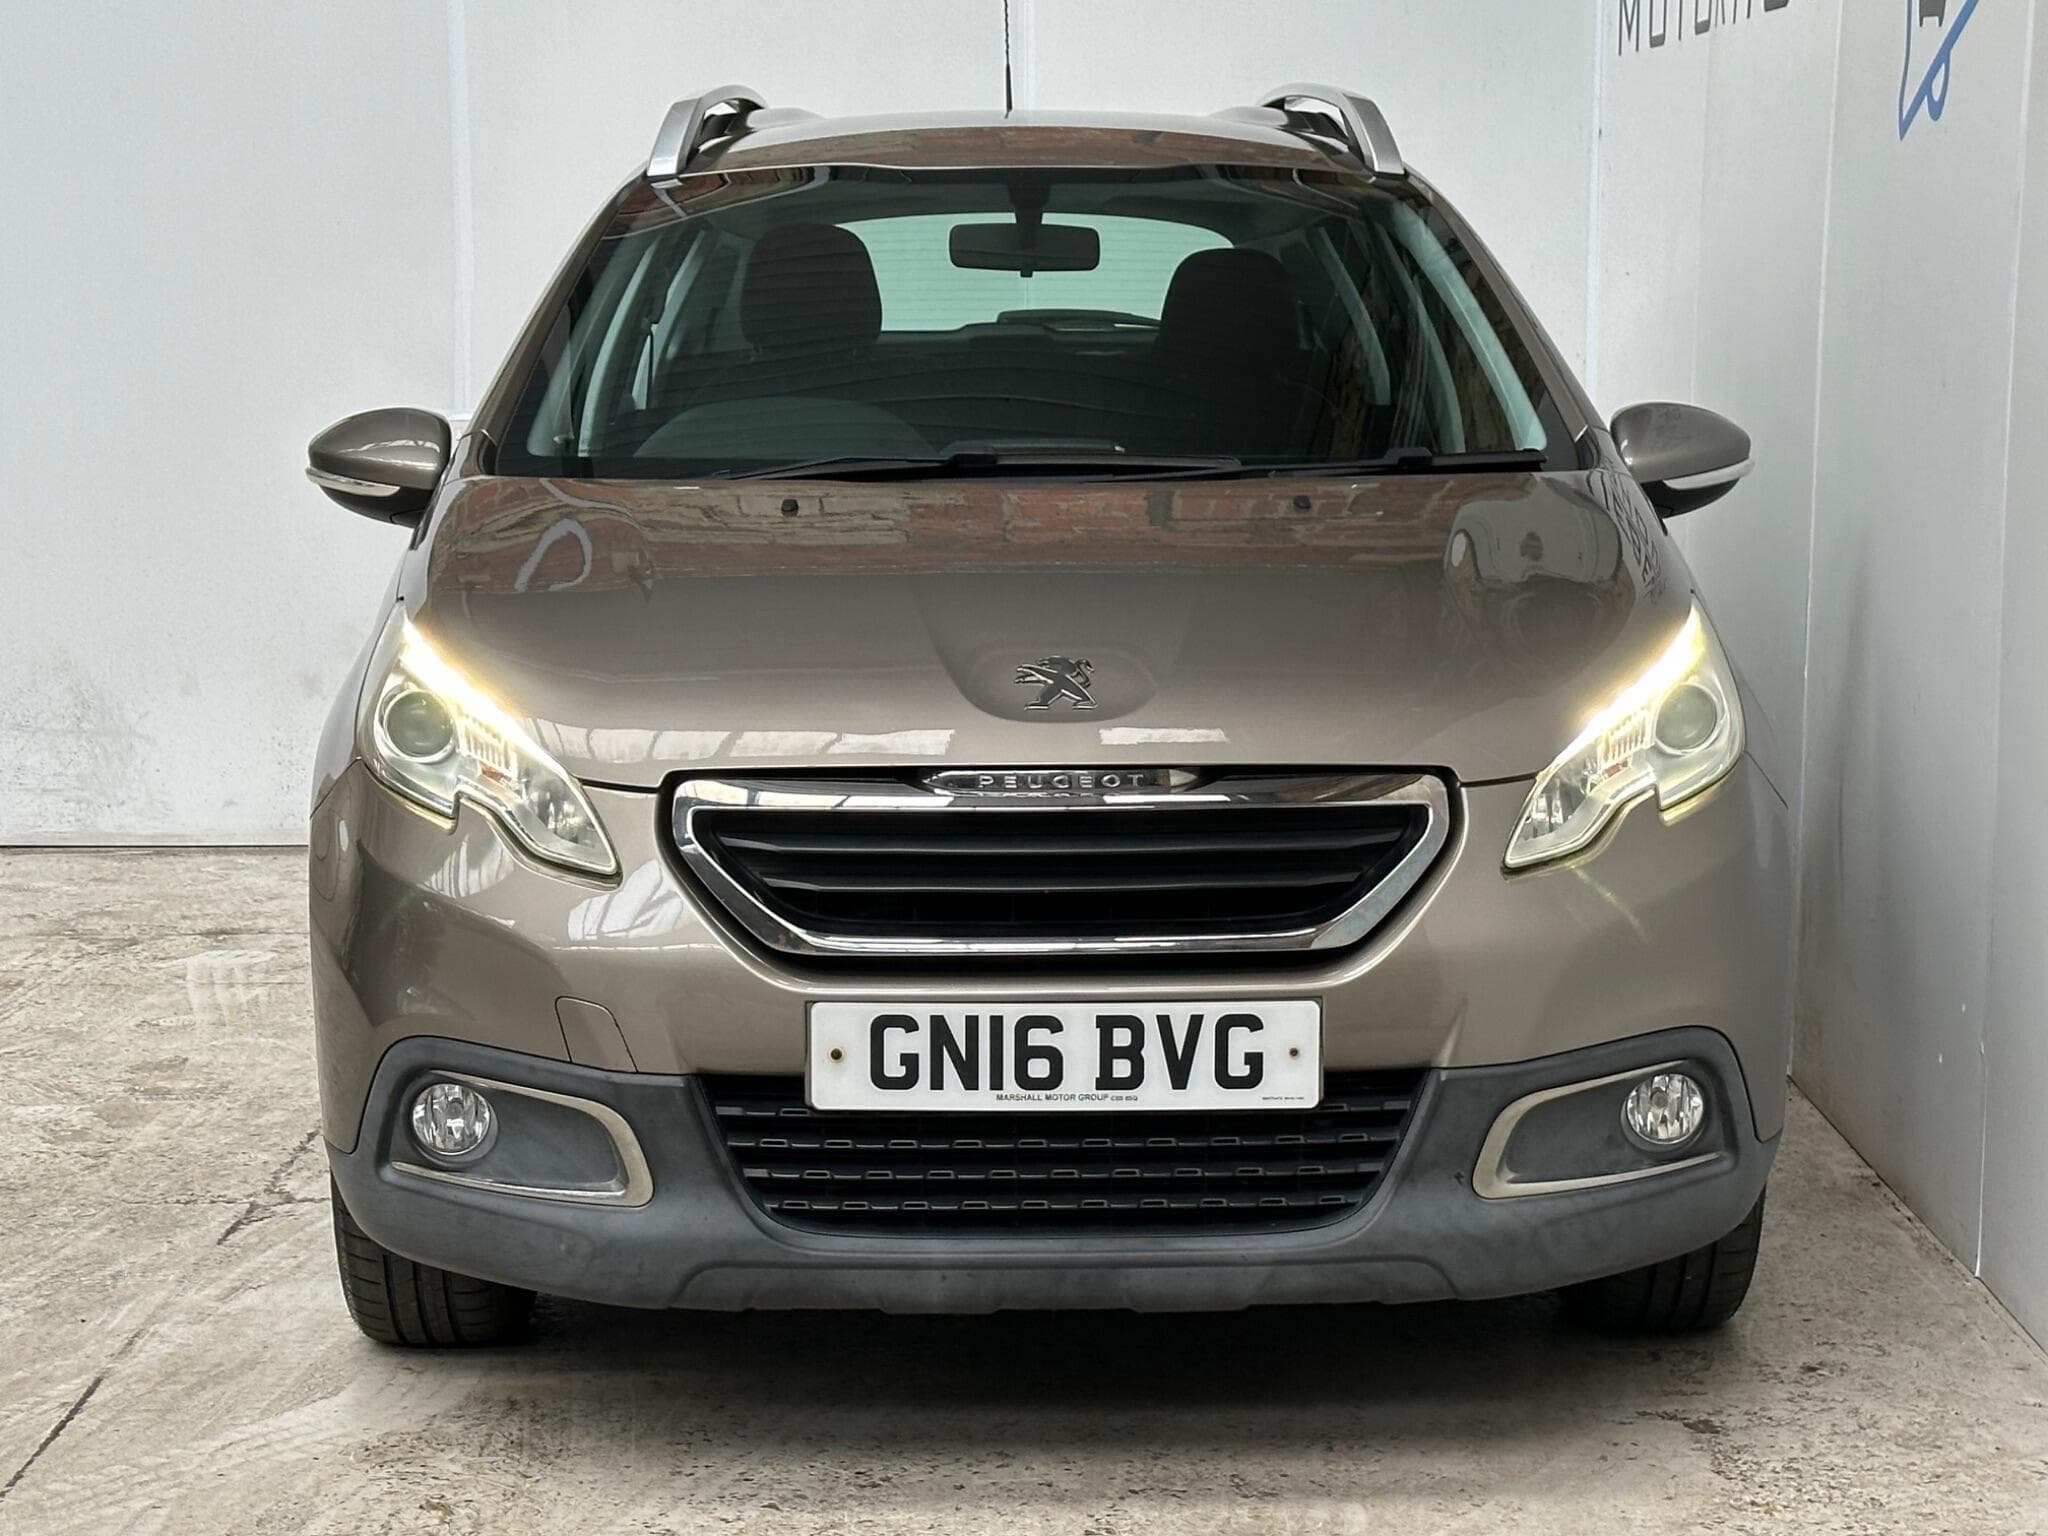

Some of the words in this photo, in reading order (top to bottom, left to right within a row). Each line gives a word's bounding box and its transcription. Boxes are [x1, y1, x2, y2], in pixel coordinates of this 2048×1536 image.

[978, 773, 1144, 789] PEUGEOT
[870, 1014, 1064, 1091] GN16
[1095, 1013, 1264, 1090] BVG
[996, 1093, 1043, 1101] MARSHALL
[1045, 1093, 1076, 1101] MOTOR
[1078, 1093, 1109, 1101] GROUP
